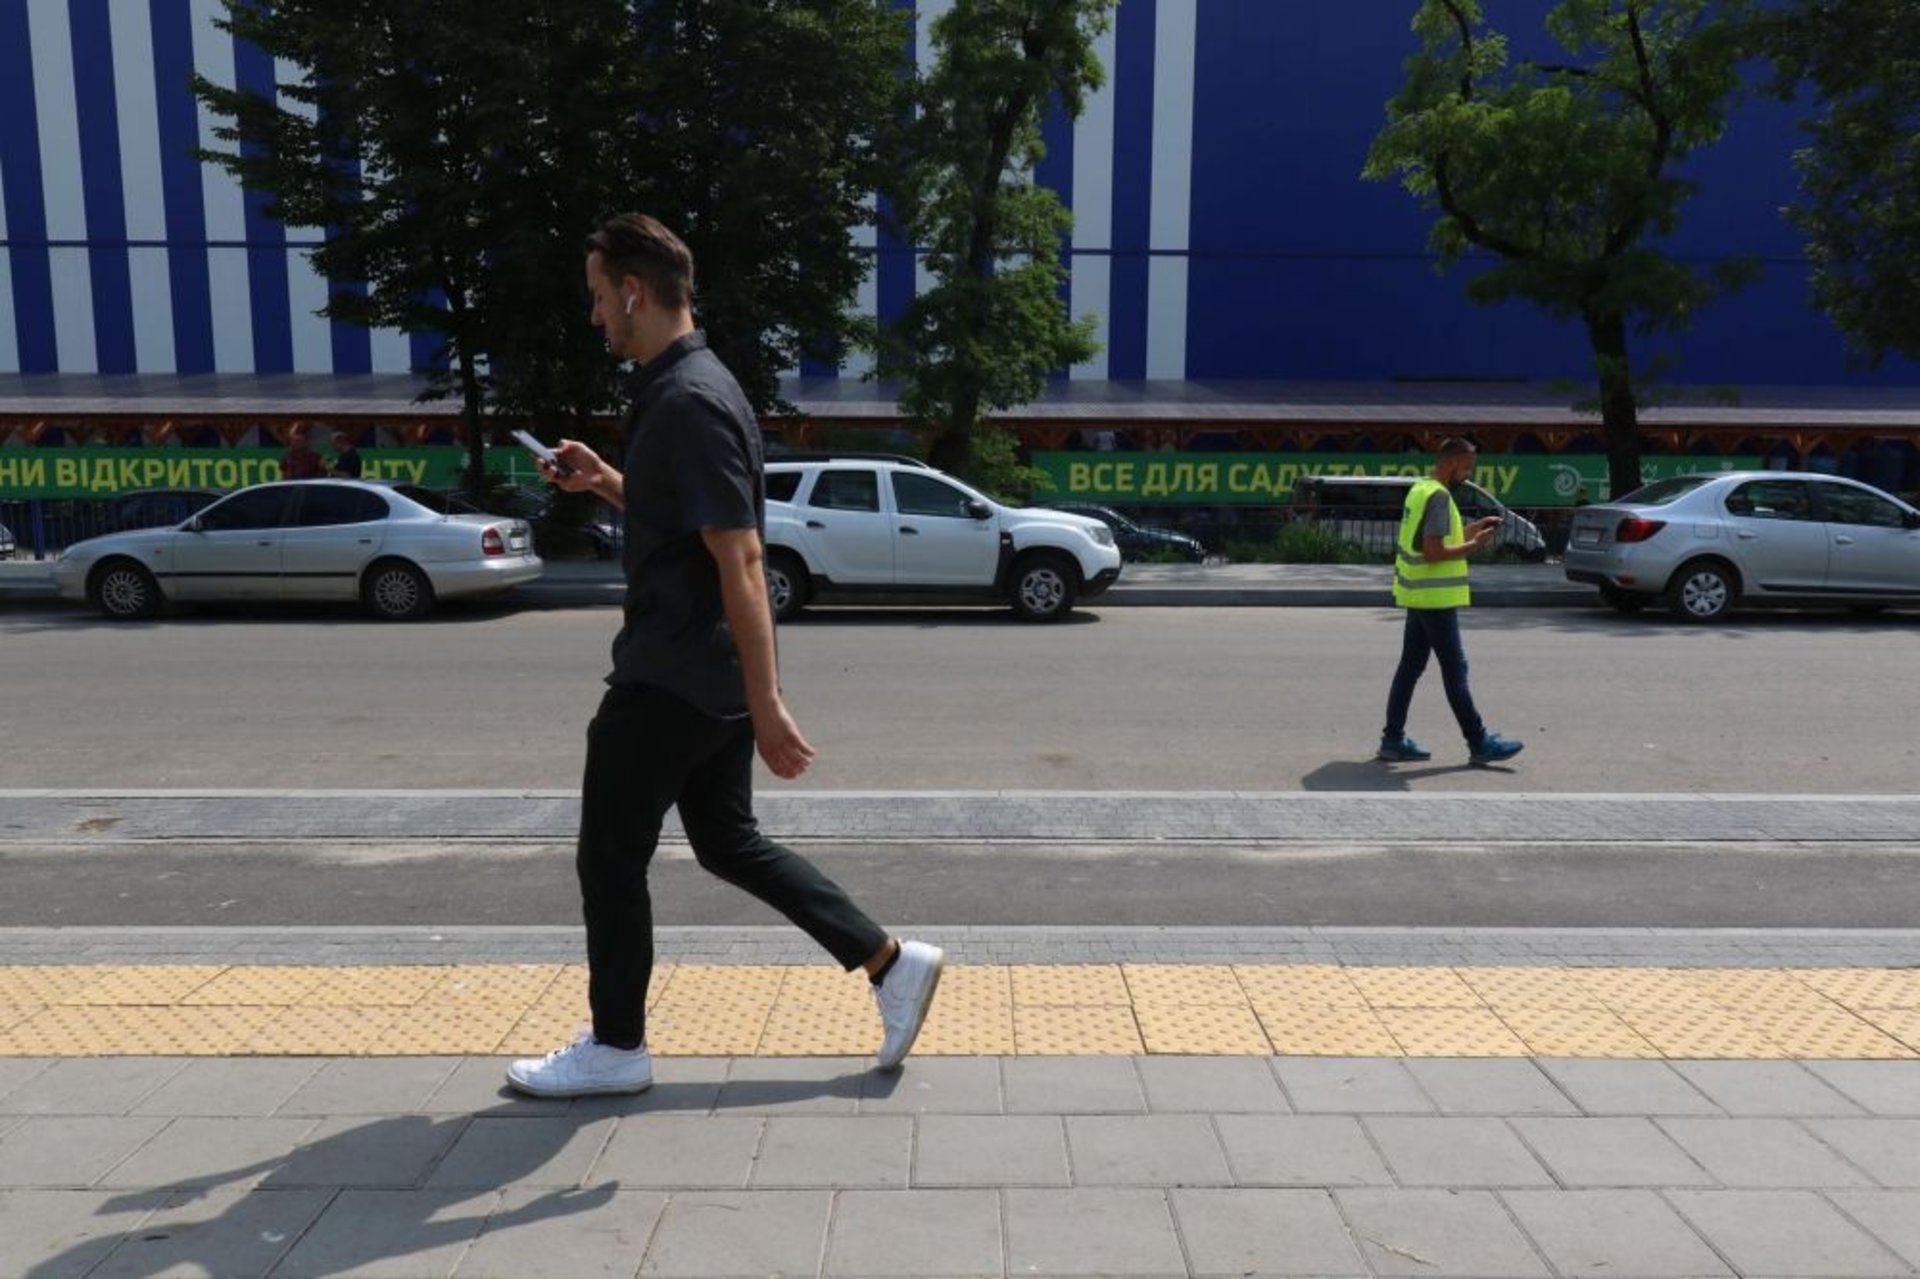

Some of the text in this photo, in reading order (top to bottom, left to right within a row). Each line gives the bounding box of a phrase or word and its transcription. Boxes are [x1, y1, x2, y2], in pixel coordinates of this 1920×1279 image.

[55, 458, 283, 493] ВІДКРИТОГО
[1069, 462, 1135, 492] ВСЕ
[1141, 462, 1218, 497] ДЛЯ
